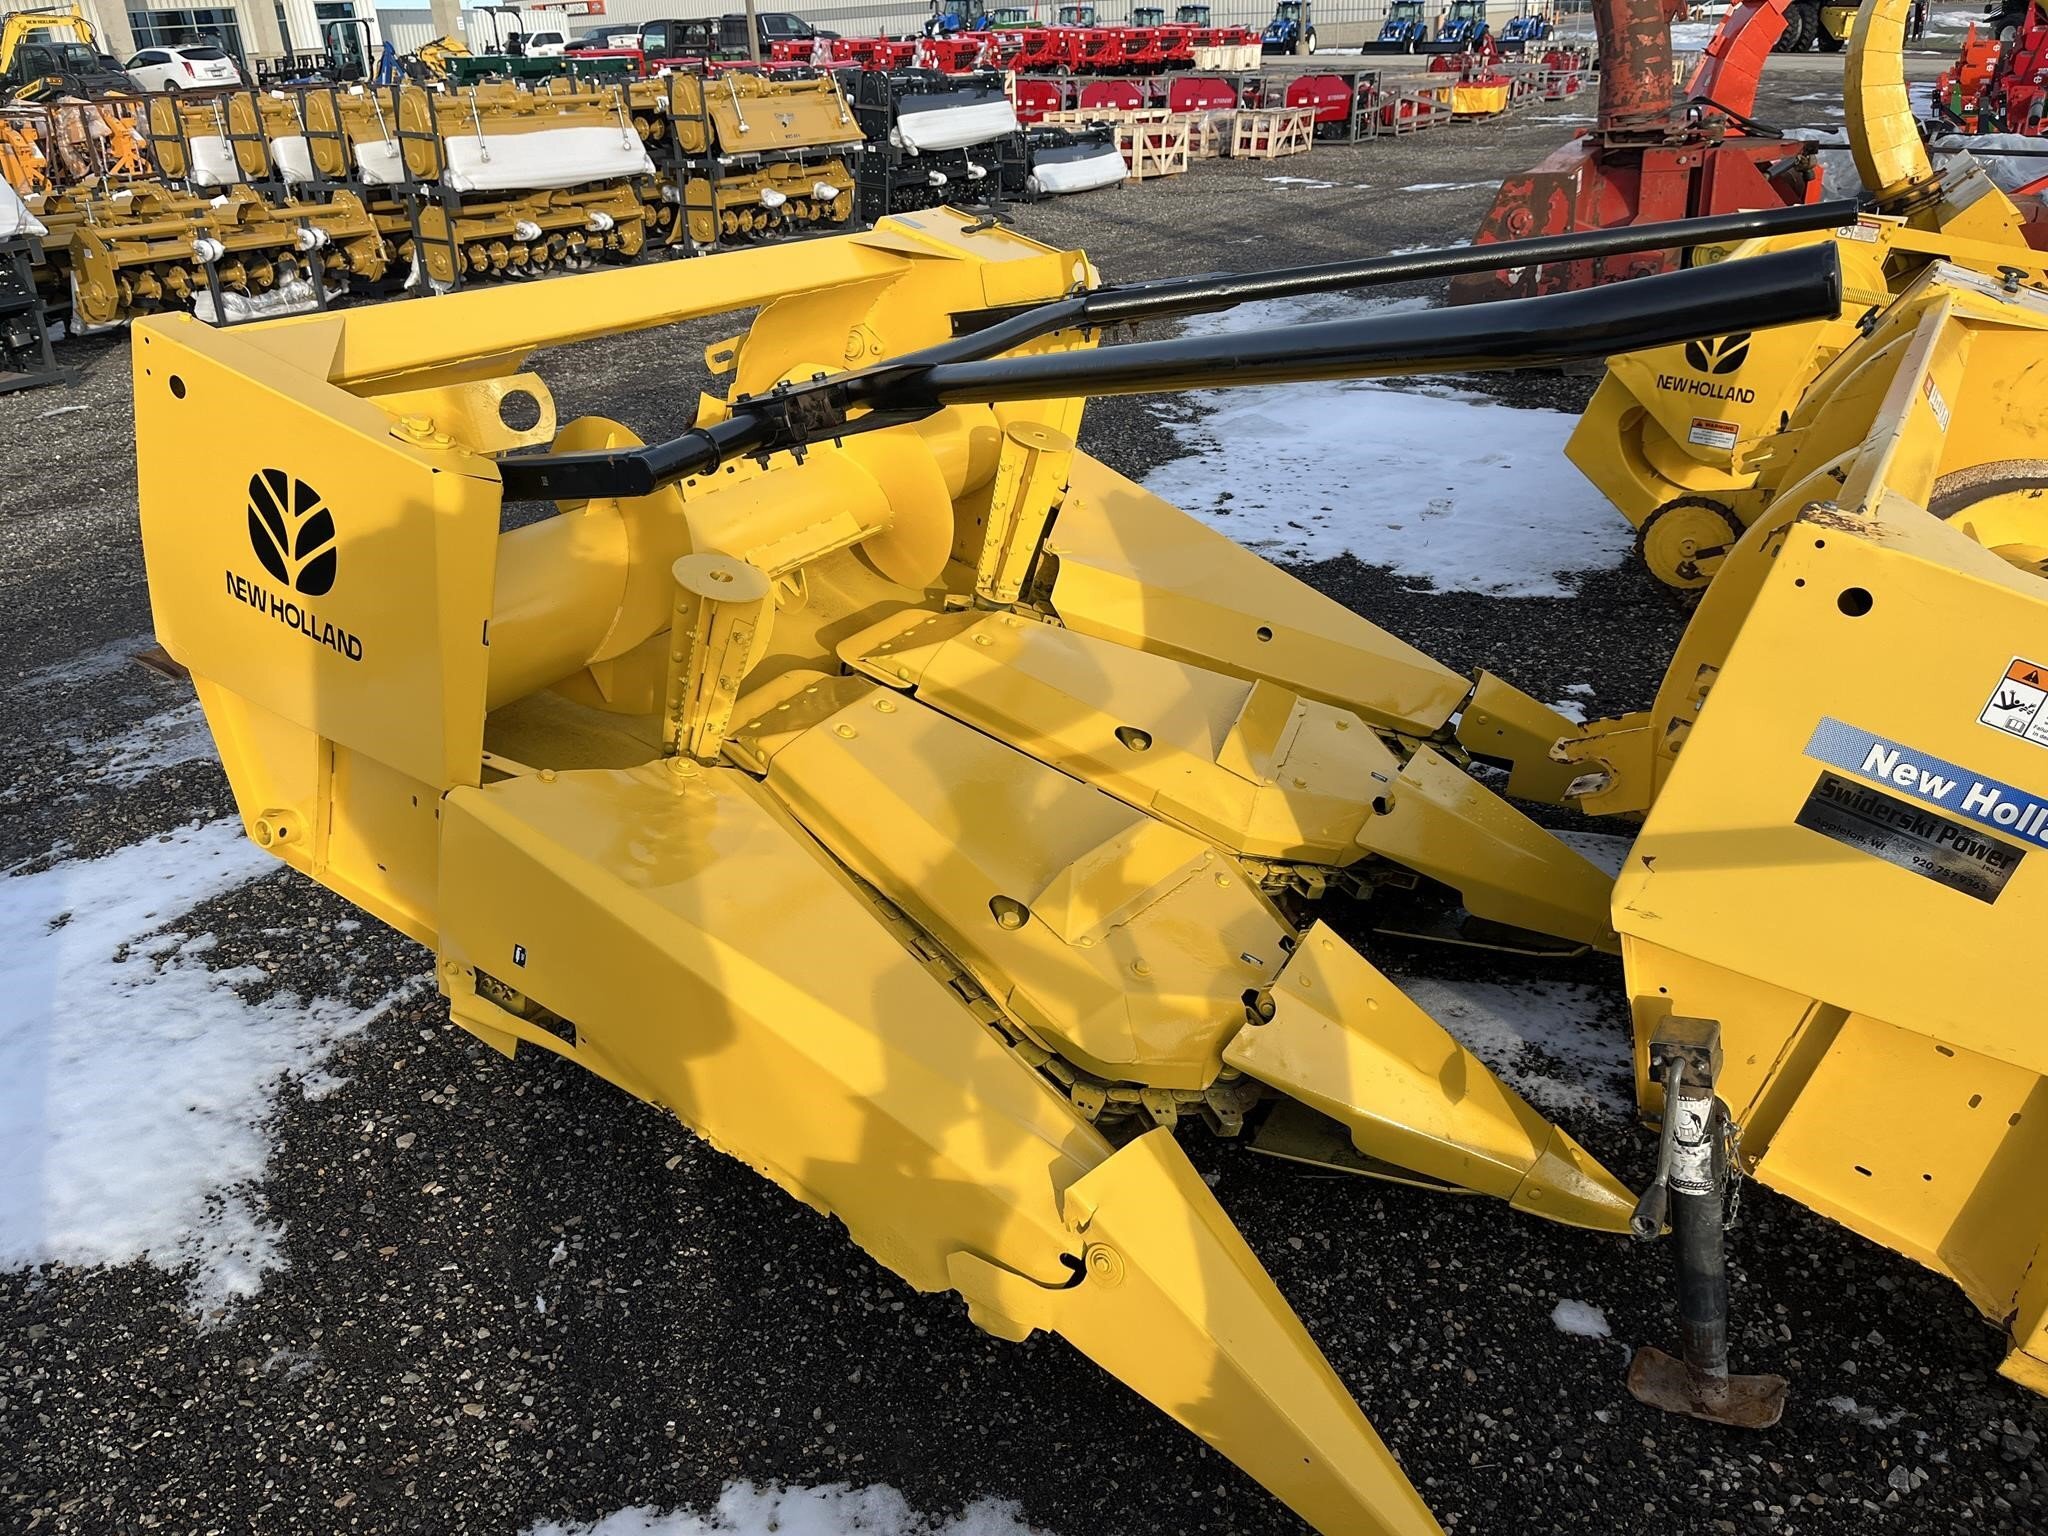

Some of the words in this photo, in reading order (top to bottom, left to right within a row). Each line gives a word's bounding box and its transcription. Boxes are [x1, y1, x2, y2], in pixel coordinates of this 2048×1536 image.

[1656, 374, 1688, 392] NEW
[1688, 380, 1755, 404] HOLLAND
[1705, 422, 1734, 432] WARNING
[226, 570, 267, 613] NEW
[270, 593, 363, 662] HOLLAND
[1860, 743, 1957, 800] New
[1813, 816, 1867, 845] Appleton,
[1870, 838, 1887, 850] WI
[1819, 777, 1936, 839] Swiderski
[1937, 827, 2016, 870] Power
[1912, 856, 1988, 892] 920.757.9363
